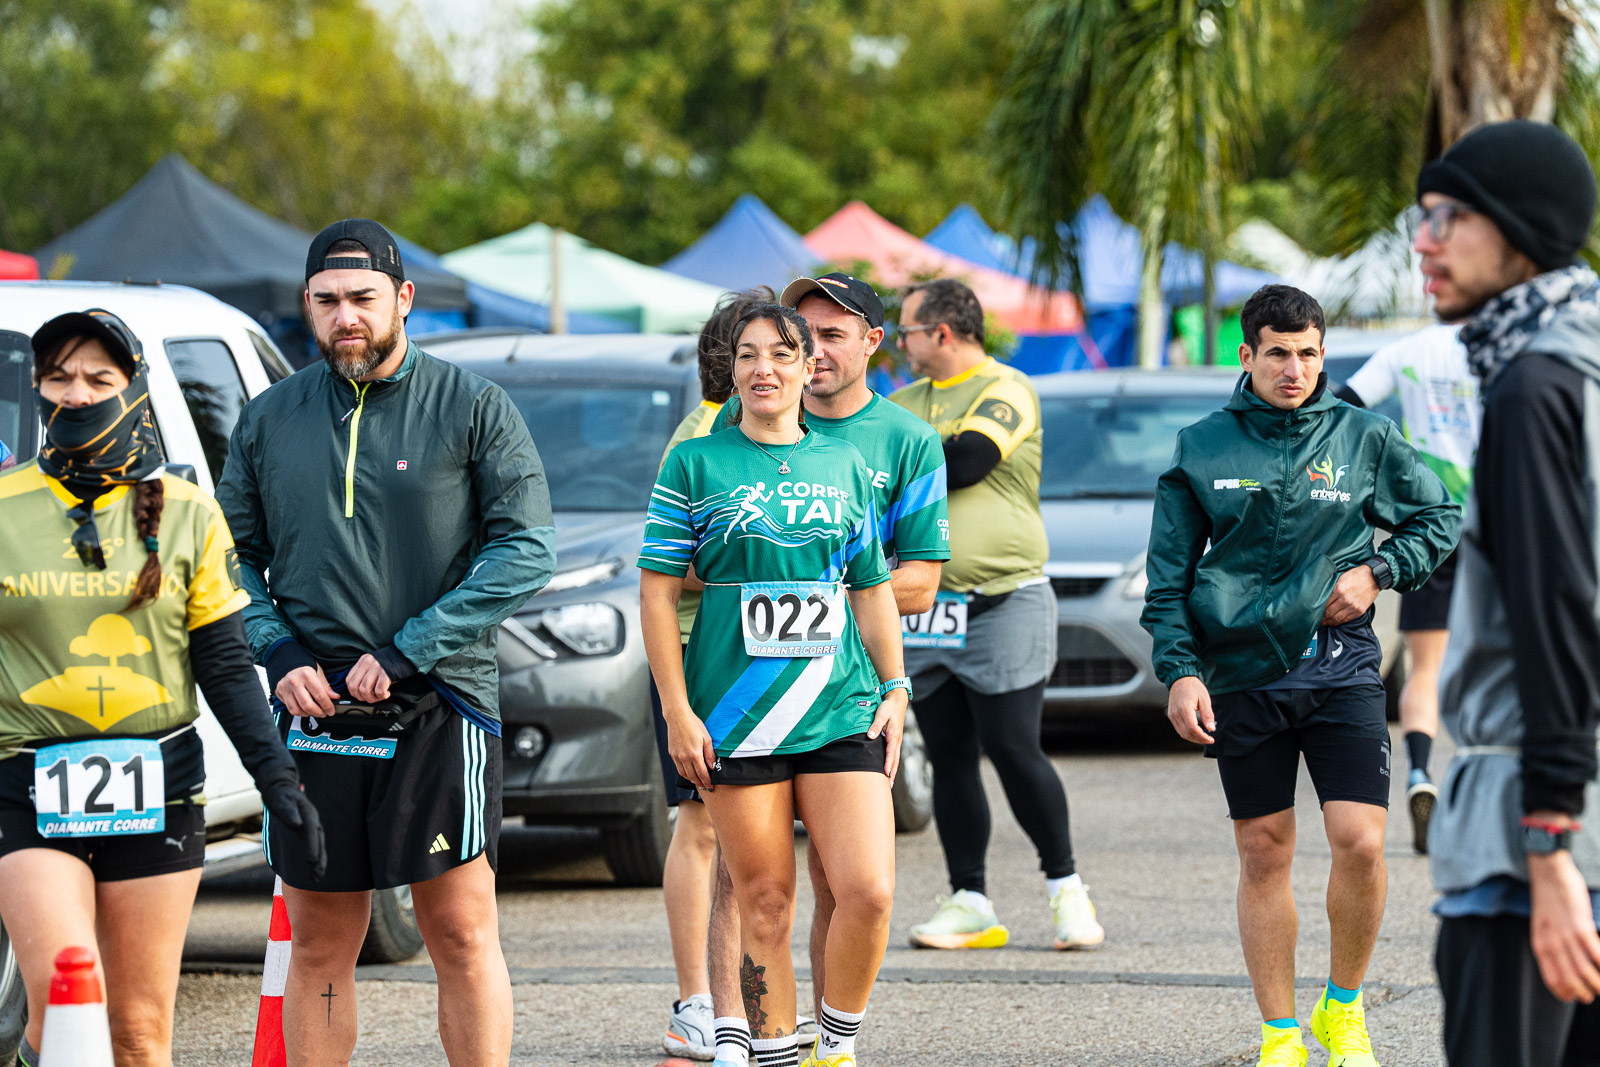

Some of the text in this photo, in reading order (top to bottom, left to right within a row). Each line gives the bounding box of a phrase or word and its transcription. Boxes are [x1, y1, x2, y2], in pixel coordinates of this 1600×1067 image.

[3, 570, 181, 598] ANIVERSAIO
[748, 593, 831, 642] 022
[751, 645, 837, 655] DIAMANTE CORRE
[291, 739, 390, 757] DIAMANTE CORRE
[46, 755, 145, 815] 121
[45, 818, 158, 834] DIAMANTE CORRE
